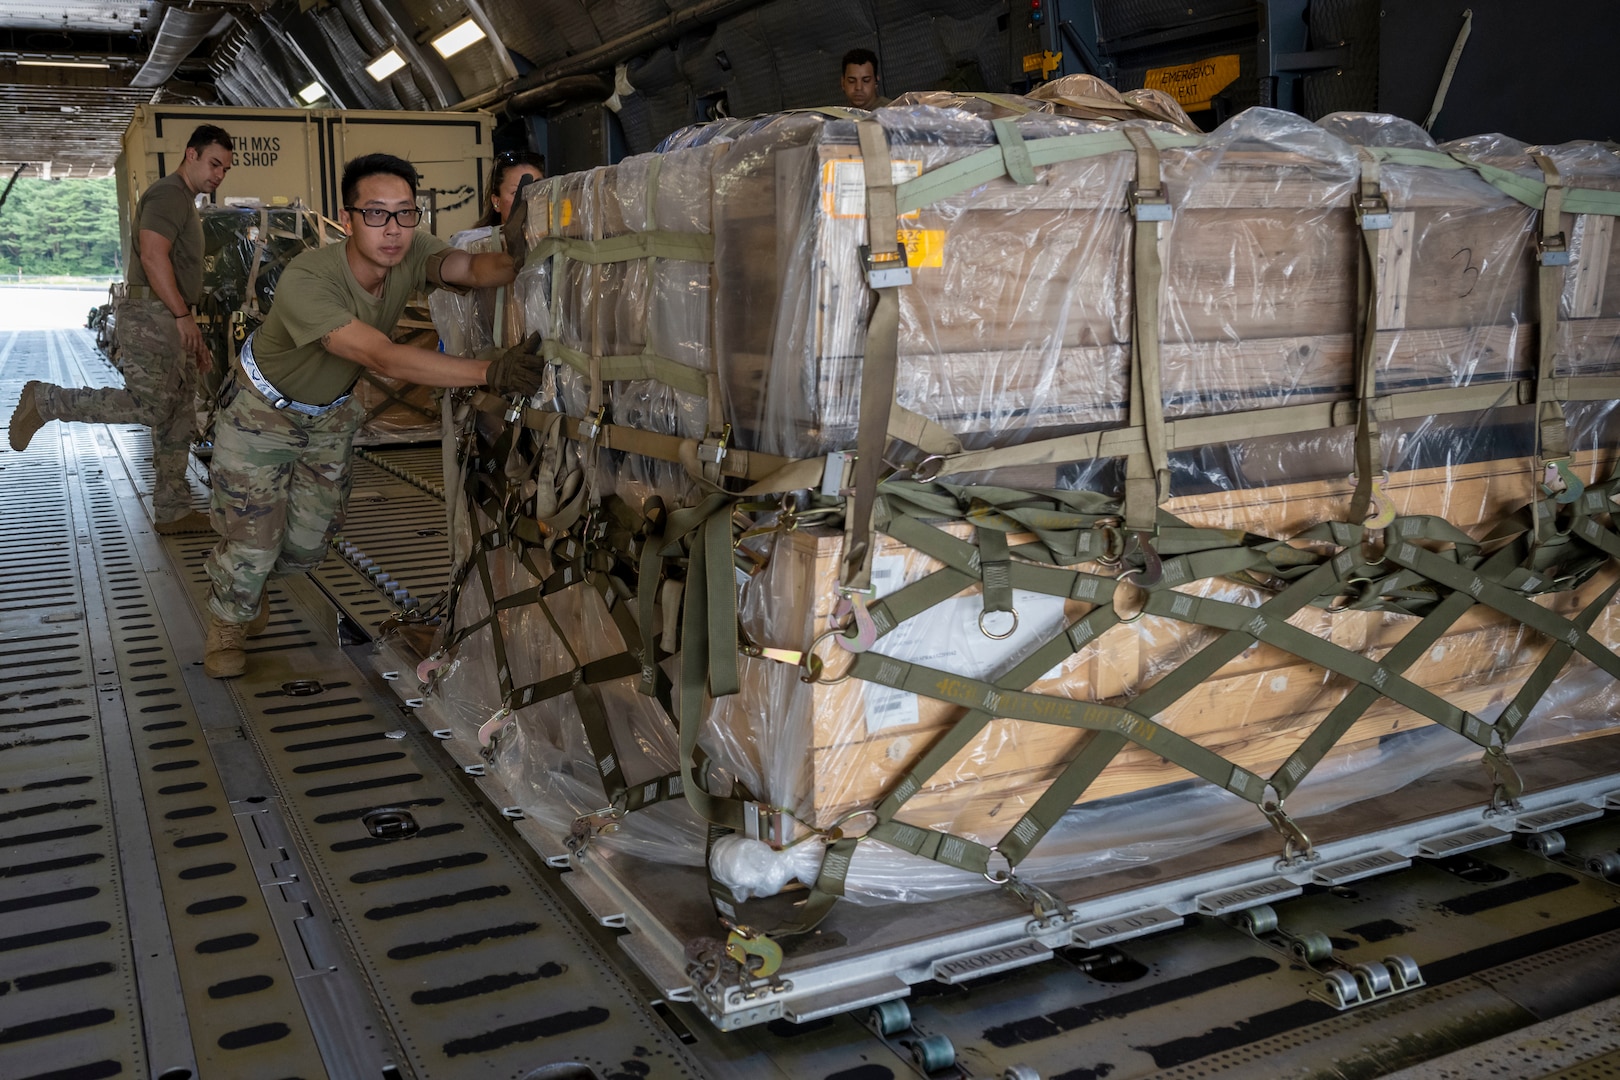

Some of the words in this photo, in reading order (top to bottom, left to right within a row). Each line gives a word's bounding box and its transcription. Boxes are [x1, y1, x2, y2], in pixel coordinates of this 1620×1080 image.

[1162, 64, 1216, 84] EMERGENCY
[1179, 84, 1198, 98] EXIT
[251, 136, 281, 151] MXS
[243, 152, 279, 167] SHOP
[1451, 247, 1479, 299] 3
[943, 942, 1039, 974] PROPERTY
